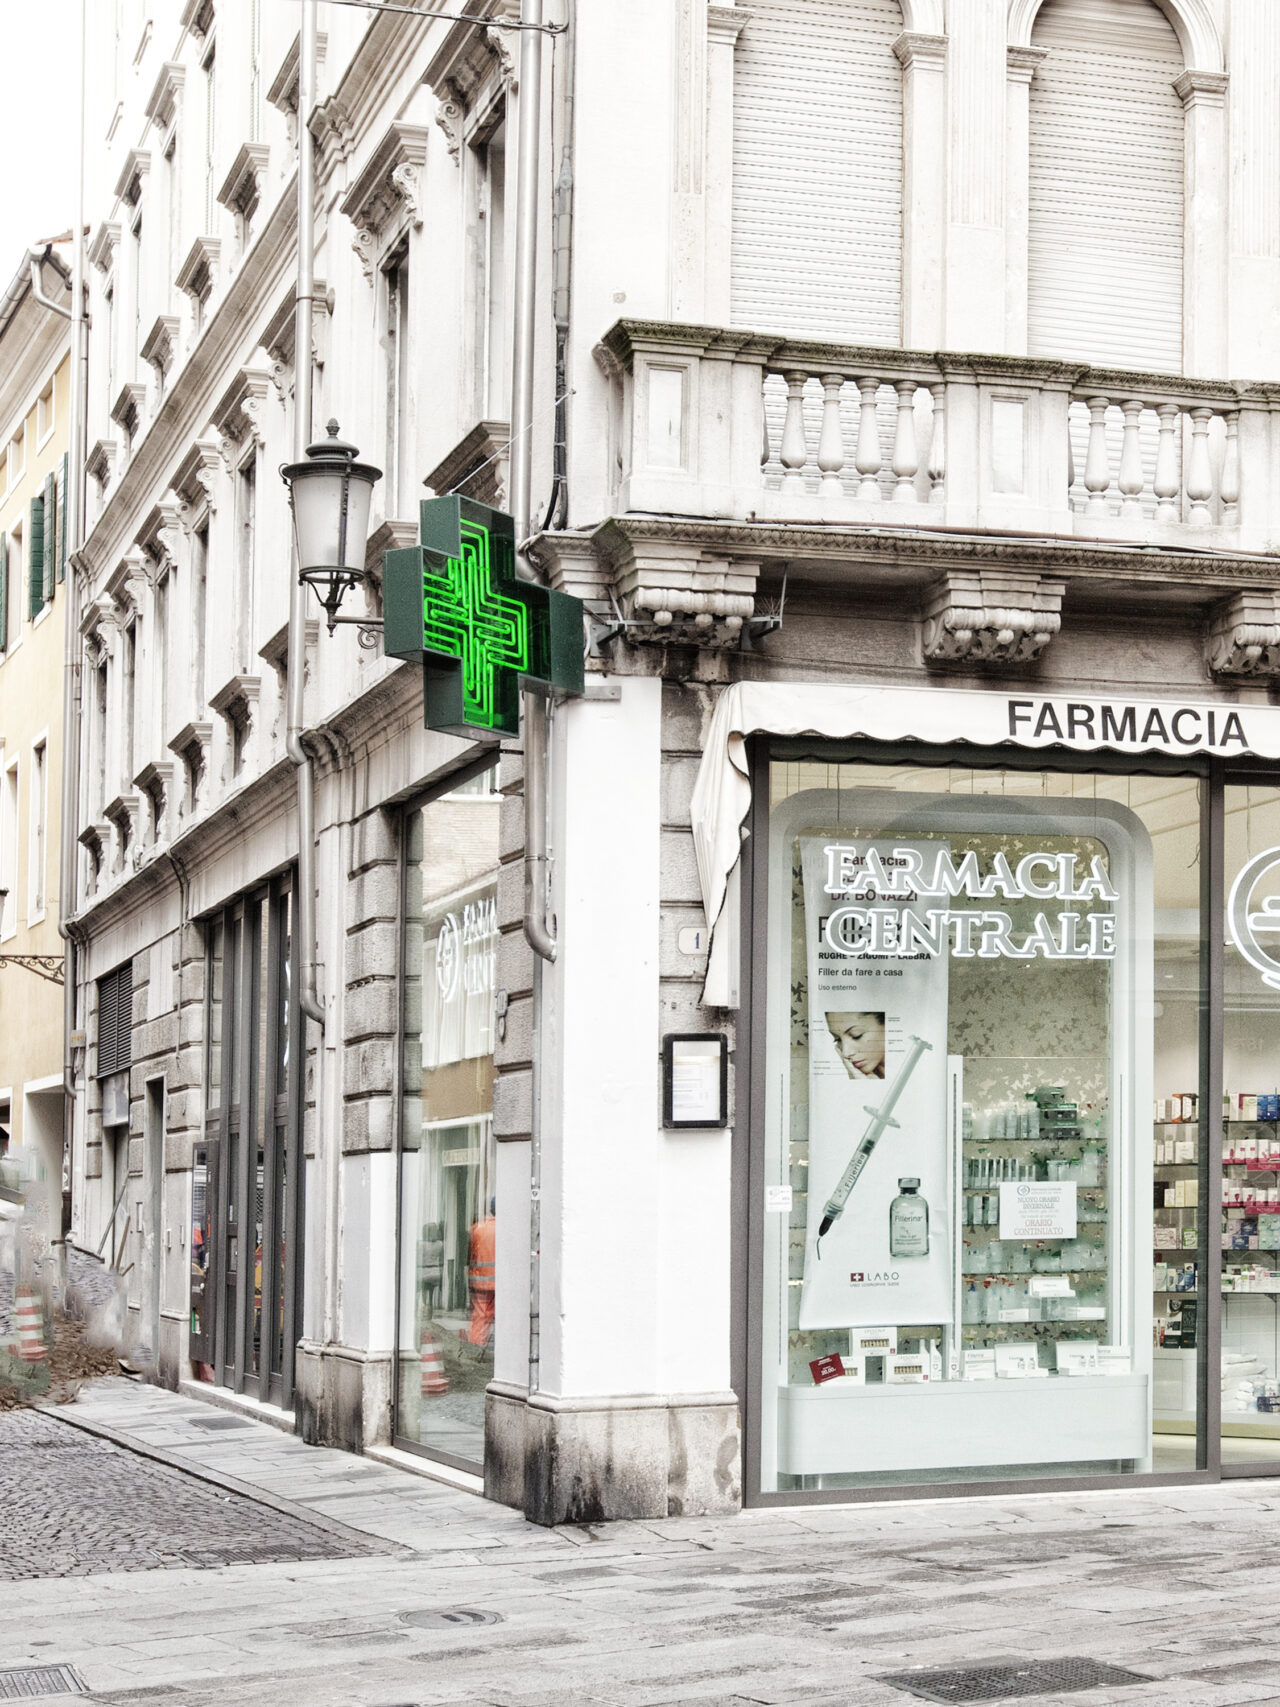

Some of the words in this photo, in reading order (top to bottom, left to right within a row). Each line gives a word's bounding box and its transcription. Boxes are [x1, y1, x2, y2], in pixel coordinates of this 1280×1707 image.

[1007, 700, 1250, 748] FARMACIA
[842, 855, 907, 866] Faracia
[823, 845, 1120, 901] FARMACIA
[824, 906, 1118, 960] CENTRALE
[818, 951, 848, 960] RUGHE
[818, 968, 839, 977] Filler
[842, 968, 853, 977] da
[855, 968, 873, 977] fare
[883, 969, 904, 977] casa
[832, 984, 858, 992] esterno
[867, 1271, 900, 1281] LABO
